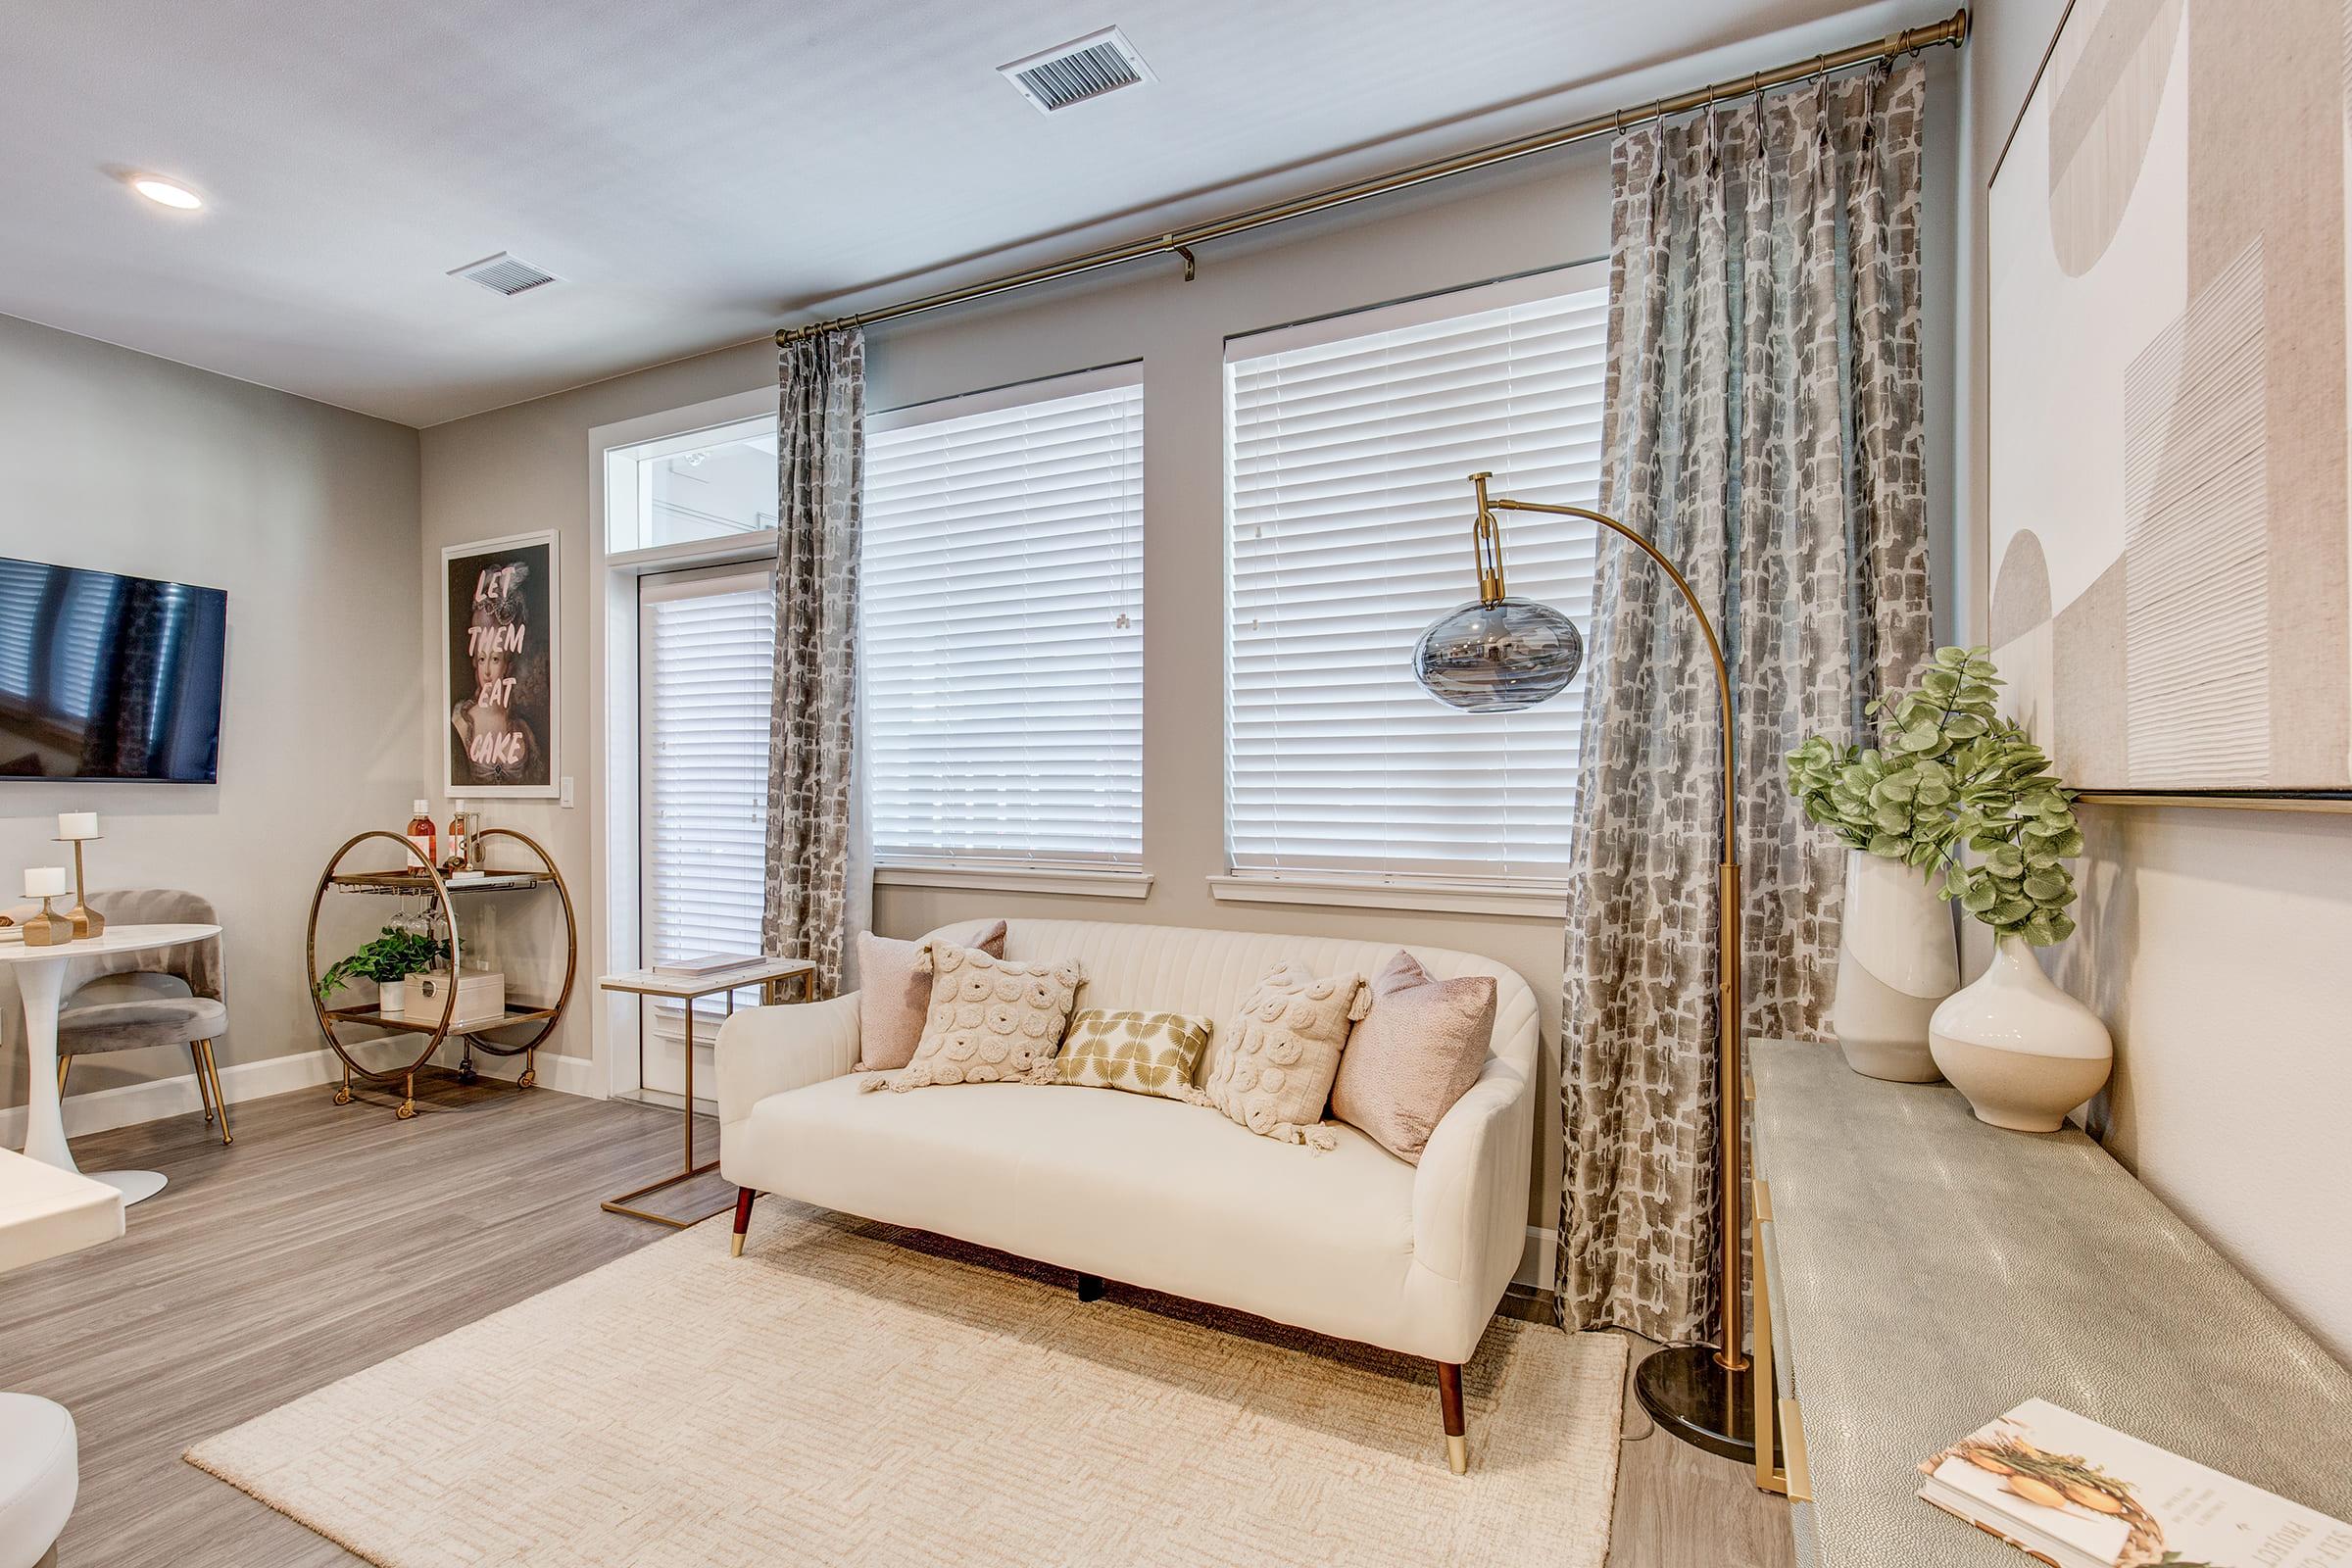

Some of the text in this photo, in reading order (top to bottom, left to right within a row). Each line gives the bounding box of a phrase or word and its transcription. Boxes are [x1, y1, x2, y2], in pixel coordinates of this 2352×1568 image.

[475, 566, 516, 603] LET
[467, 622, 526, 657] THEM
[477, 677, 517, 709] EAT
[469, 731, 524, 764] CAKE
[2251, 1520, 2312, 1568] PROJECT
